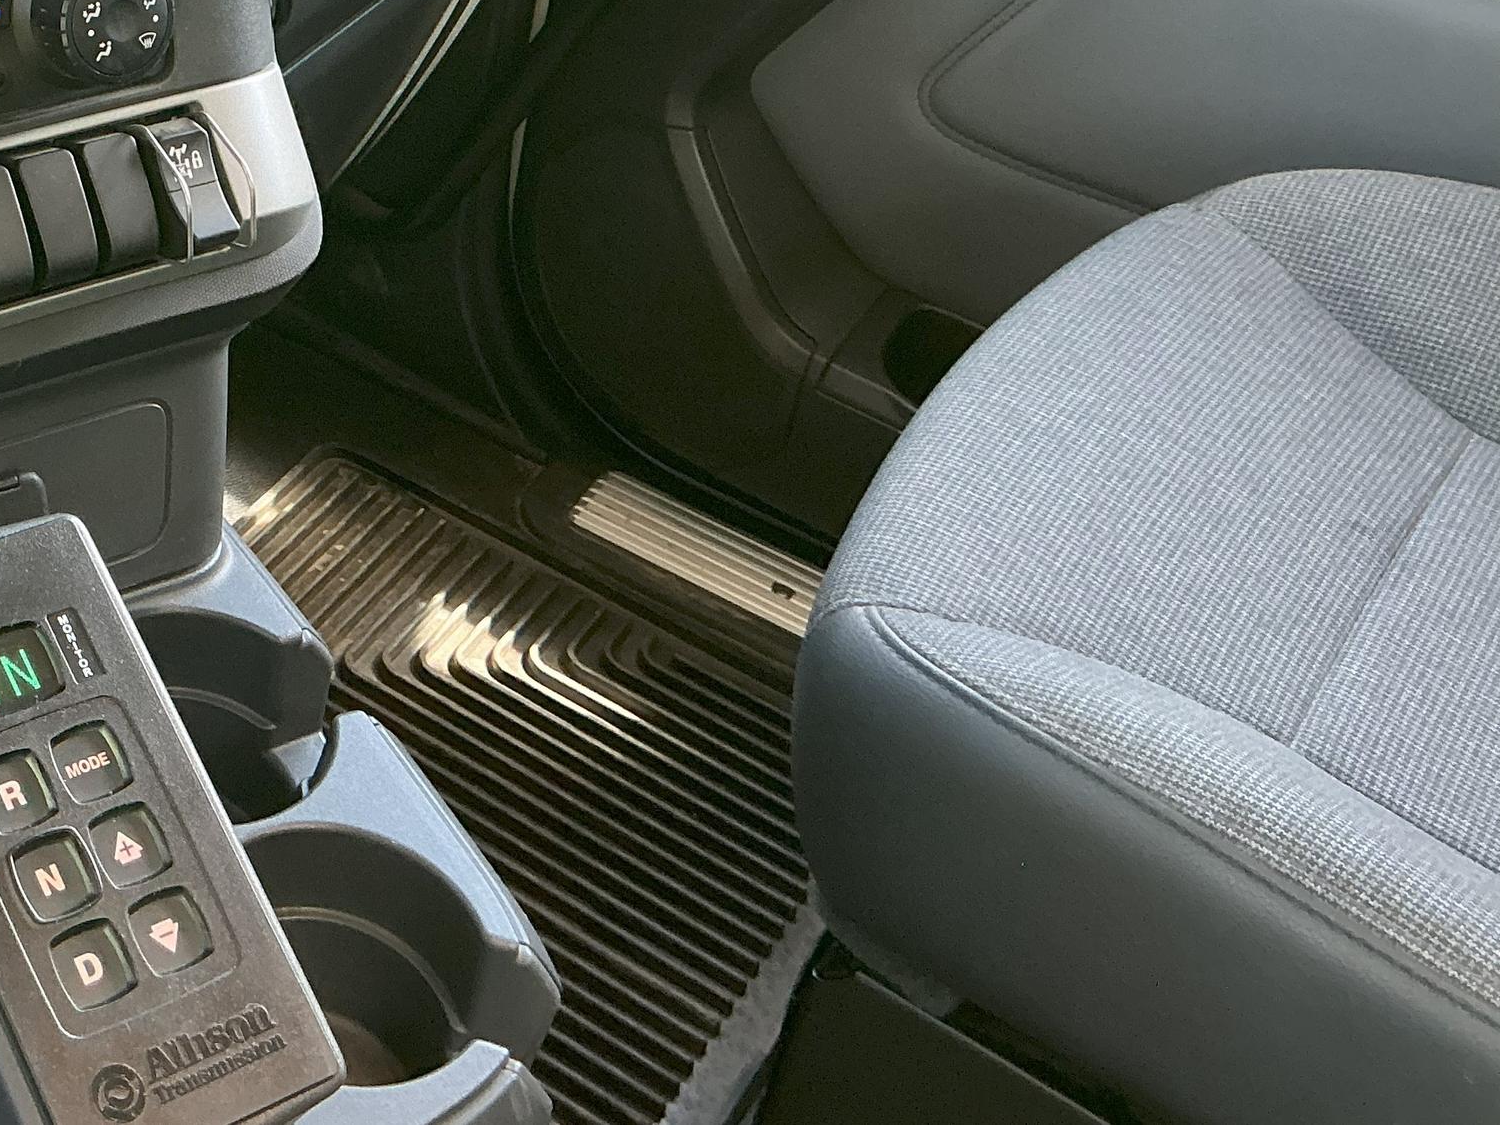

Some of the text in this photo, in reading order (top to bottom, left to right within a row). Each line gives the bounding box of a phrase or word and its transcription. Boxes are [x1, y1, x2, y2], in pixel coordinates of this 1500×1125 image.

[57, 613, 94, 678] MONITOR
[0, 648, 41, 697] N
[65, 750, 111, 780] MODE
[34, 862, 66, 898] N
[73, 953, 104, 986] D
[142, 1002, 277, 1084] Allison
[152, 1032, 286, 1106] Transmission
